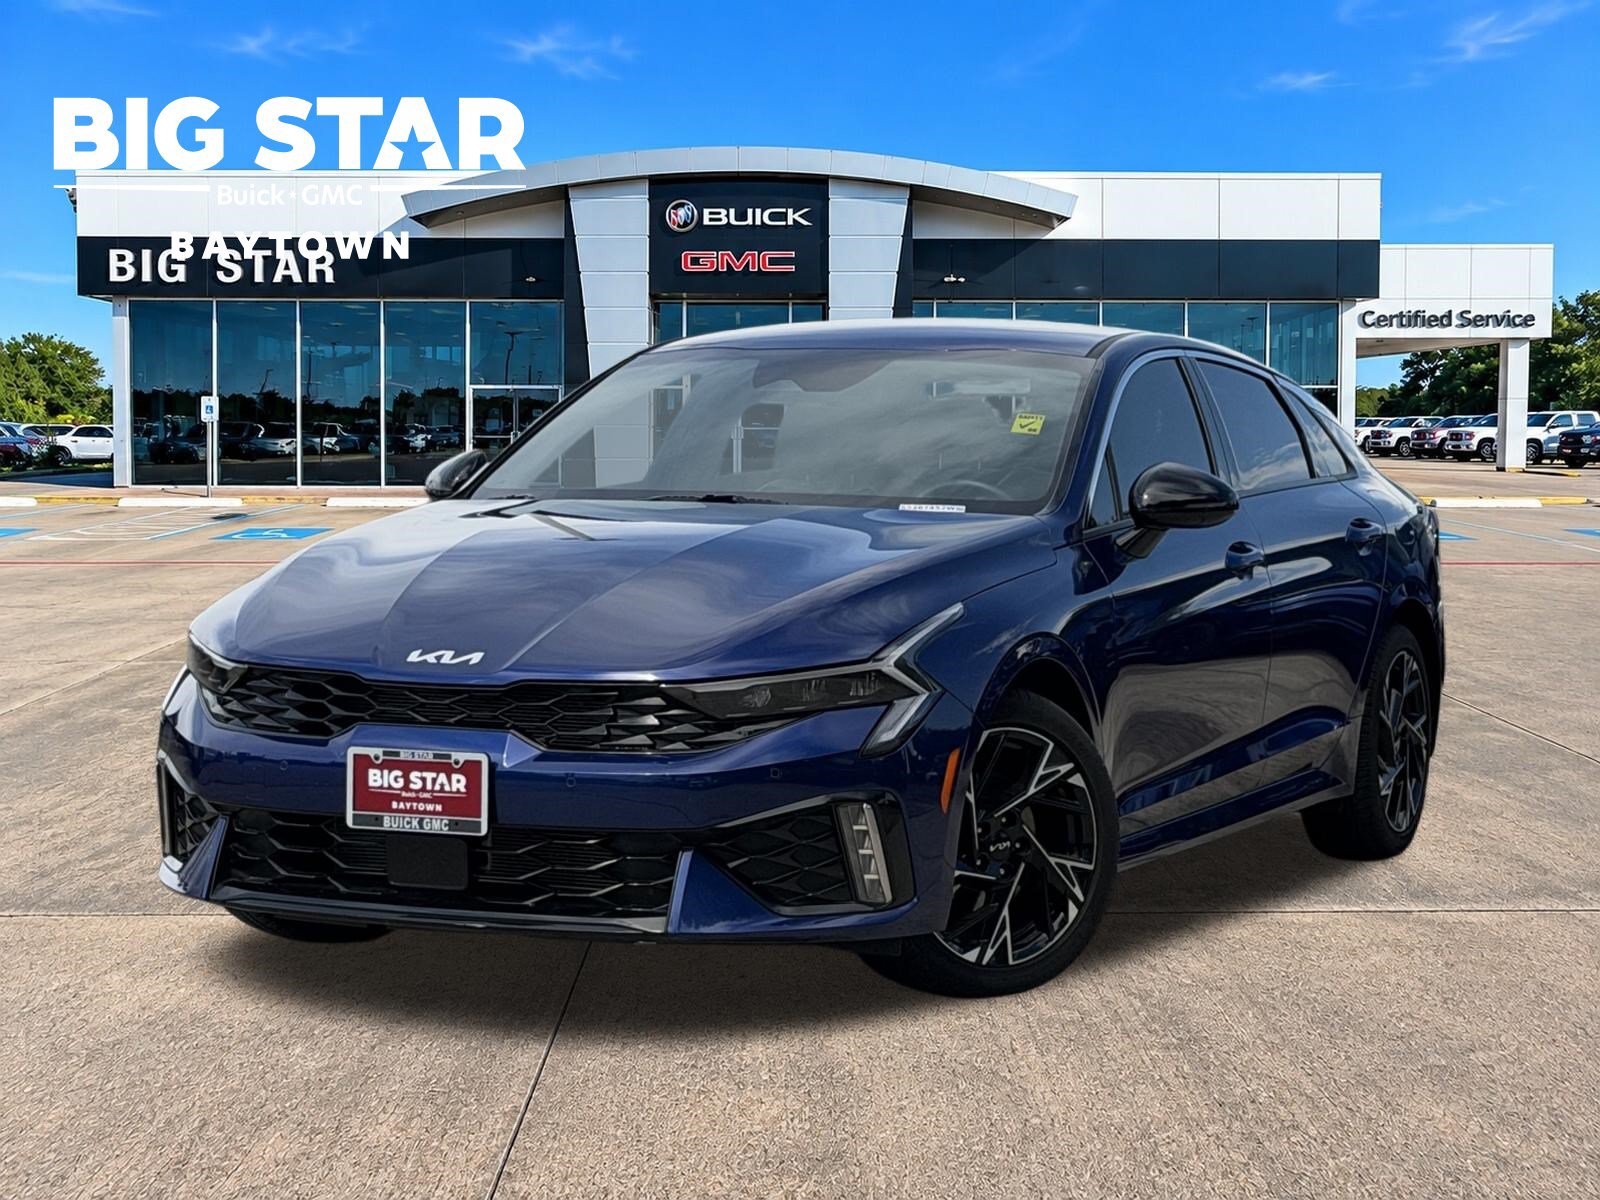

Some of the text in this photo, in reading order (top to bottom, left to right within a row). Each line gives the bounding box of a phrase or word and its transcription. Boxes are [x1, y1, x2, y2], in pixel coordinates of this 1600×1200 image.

[703, 208, 813, 226] BUICK
[108, 248, 336, 284] BIG STAR
[681, 251, 796, 272] GMC
[1360, 310, 1535, 328] Certified Service
[368, 768, 467, 793] BIG STAR
[391, 800, 443, 813] BAYTOWN
[383, 815, 449, 832] BUICK GMC
